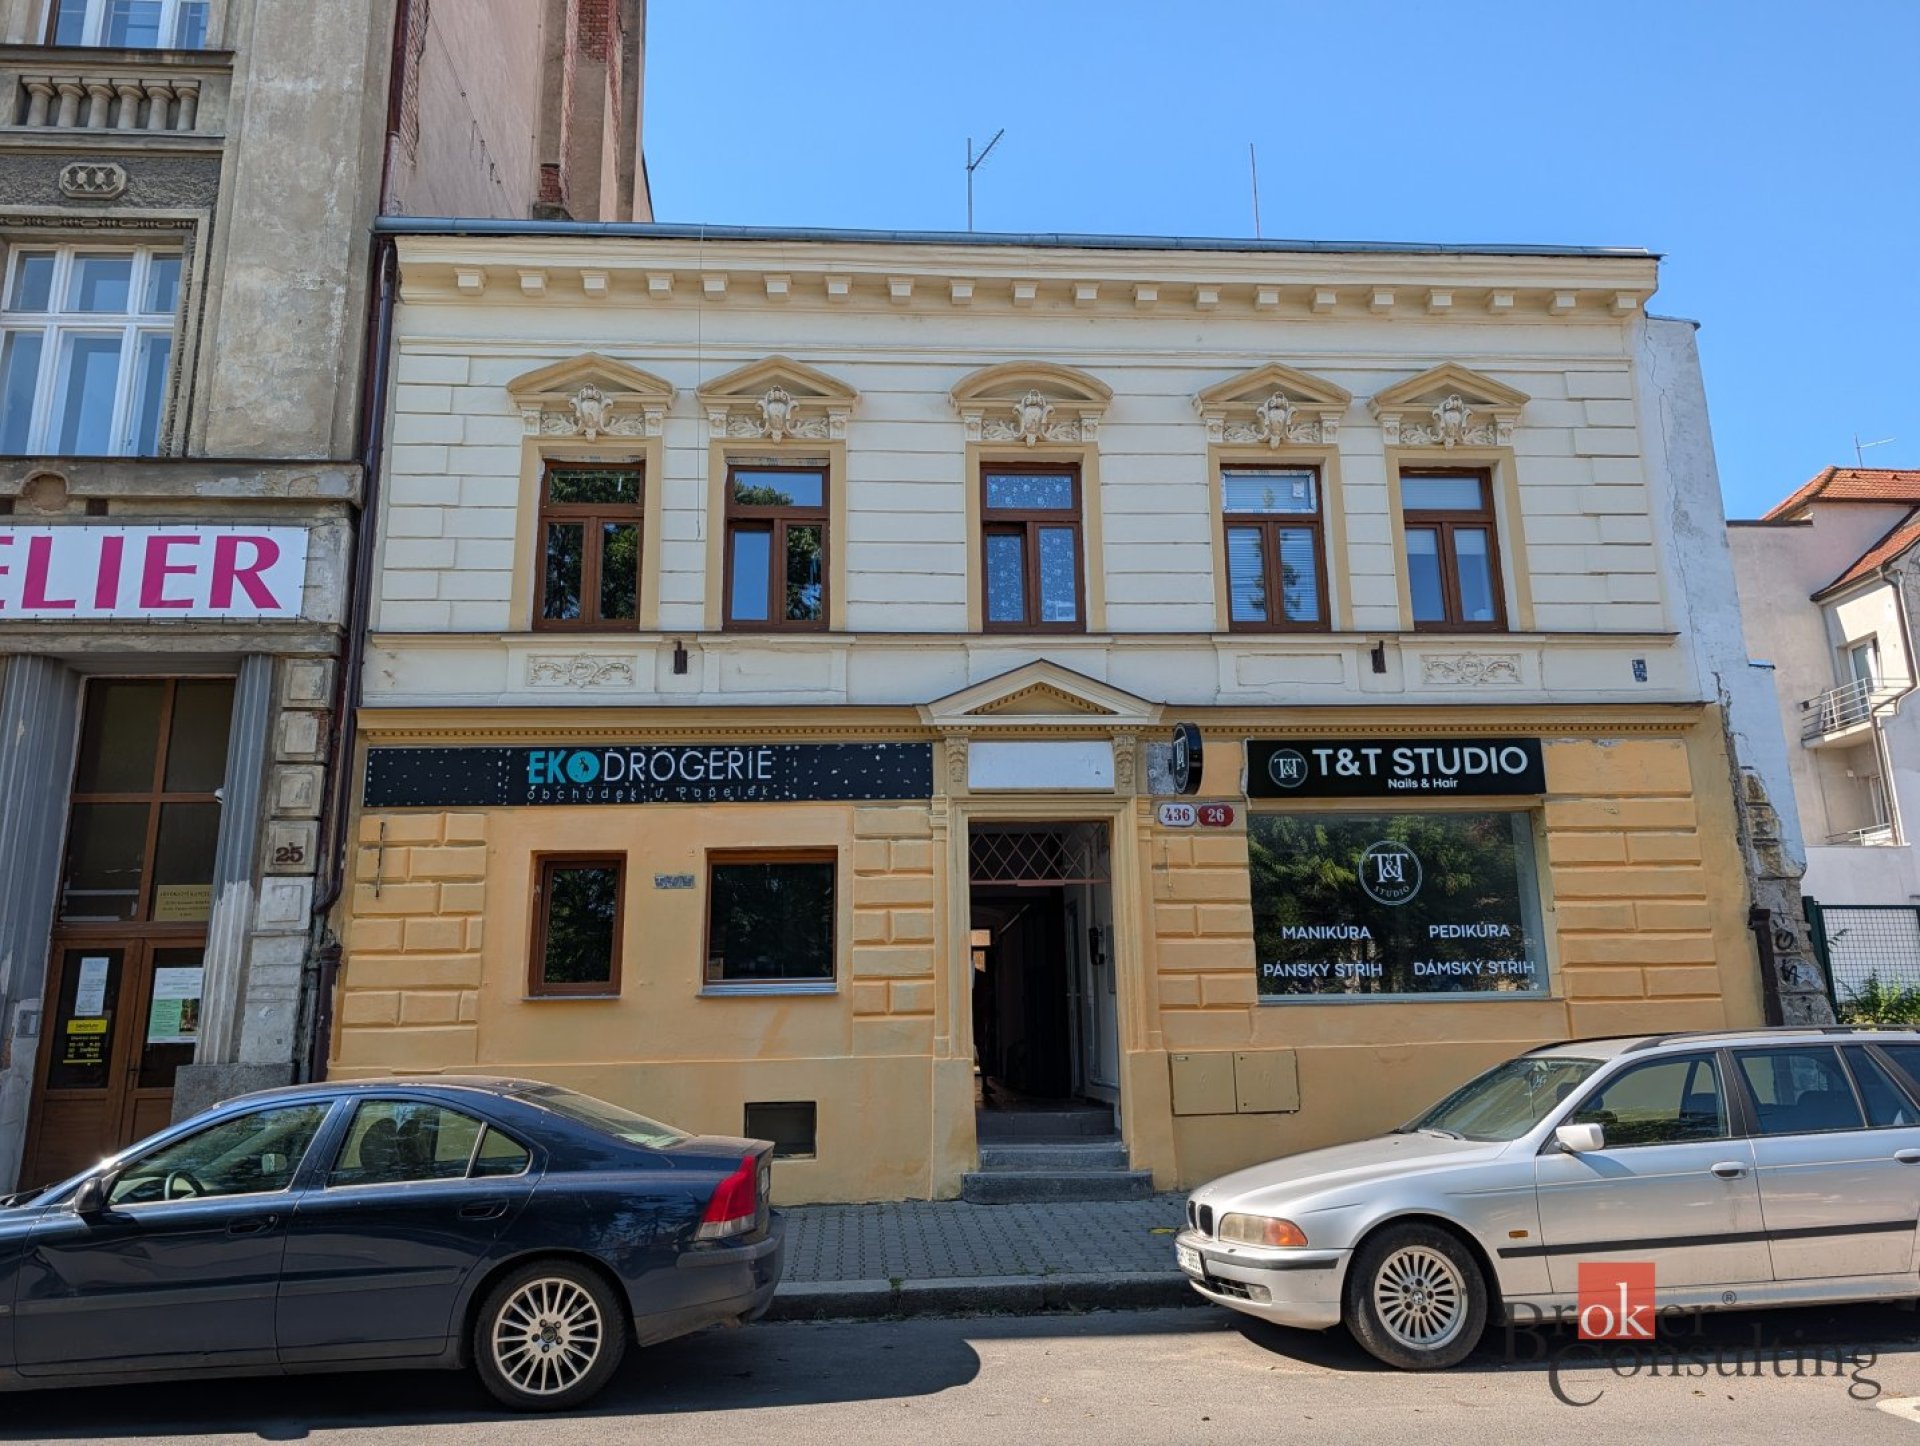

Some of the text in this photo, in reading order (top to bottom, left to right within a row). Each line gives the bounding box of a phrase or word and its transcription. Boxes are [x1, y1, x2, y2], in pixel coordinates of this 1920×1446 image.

[0, 535, 282, 609] LIER
[1274, 758, 1301, 779] T&T
[1312, 746, 1529, 776] T&T STUDIO
[1387, 778, 1459, 790] Nails & Hair
[1164, 808, 1190, 822] 436
[1207, 808, 1225, 822] 26
[275, 846, 304, 863] 25
[1369, 853, 1409, 883] T&T
[1373, 885, 1411, 898] STUDIO
[1282, 922, 1372, 941] MANIKÚRA
[1429, 921, 1511, 938] PEDIKÚRA
[1263, 960, 1384, 977] PÁNSKÝ STŘIH
[1413, 957, 1536, 976] DÁMSKÝ STŘIH
